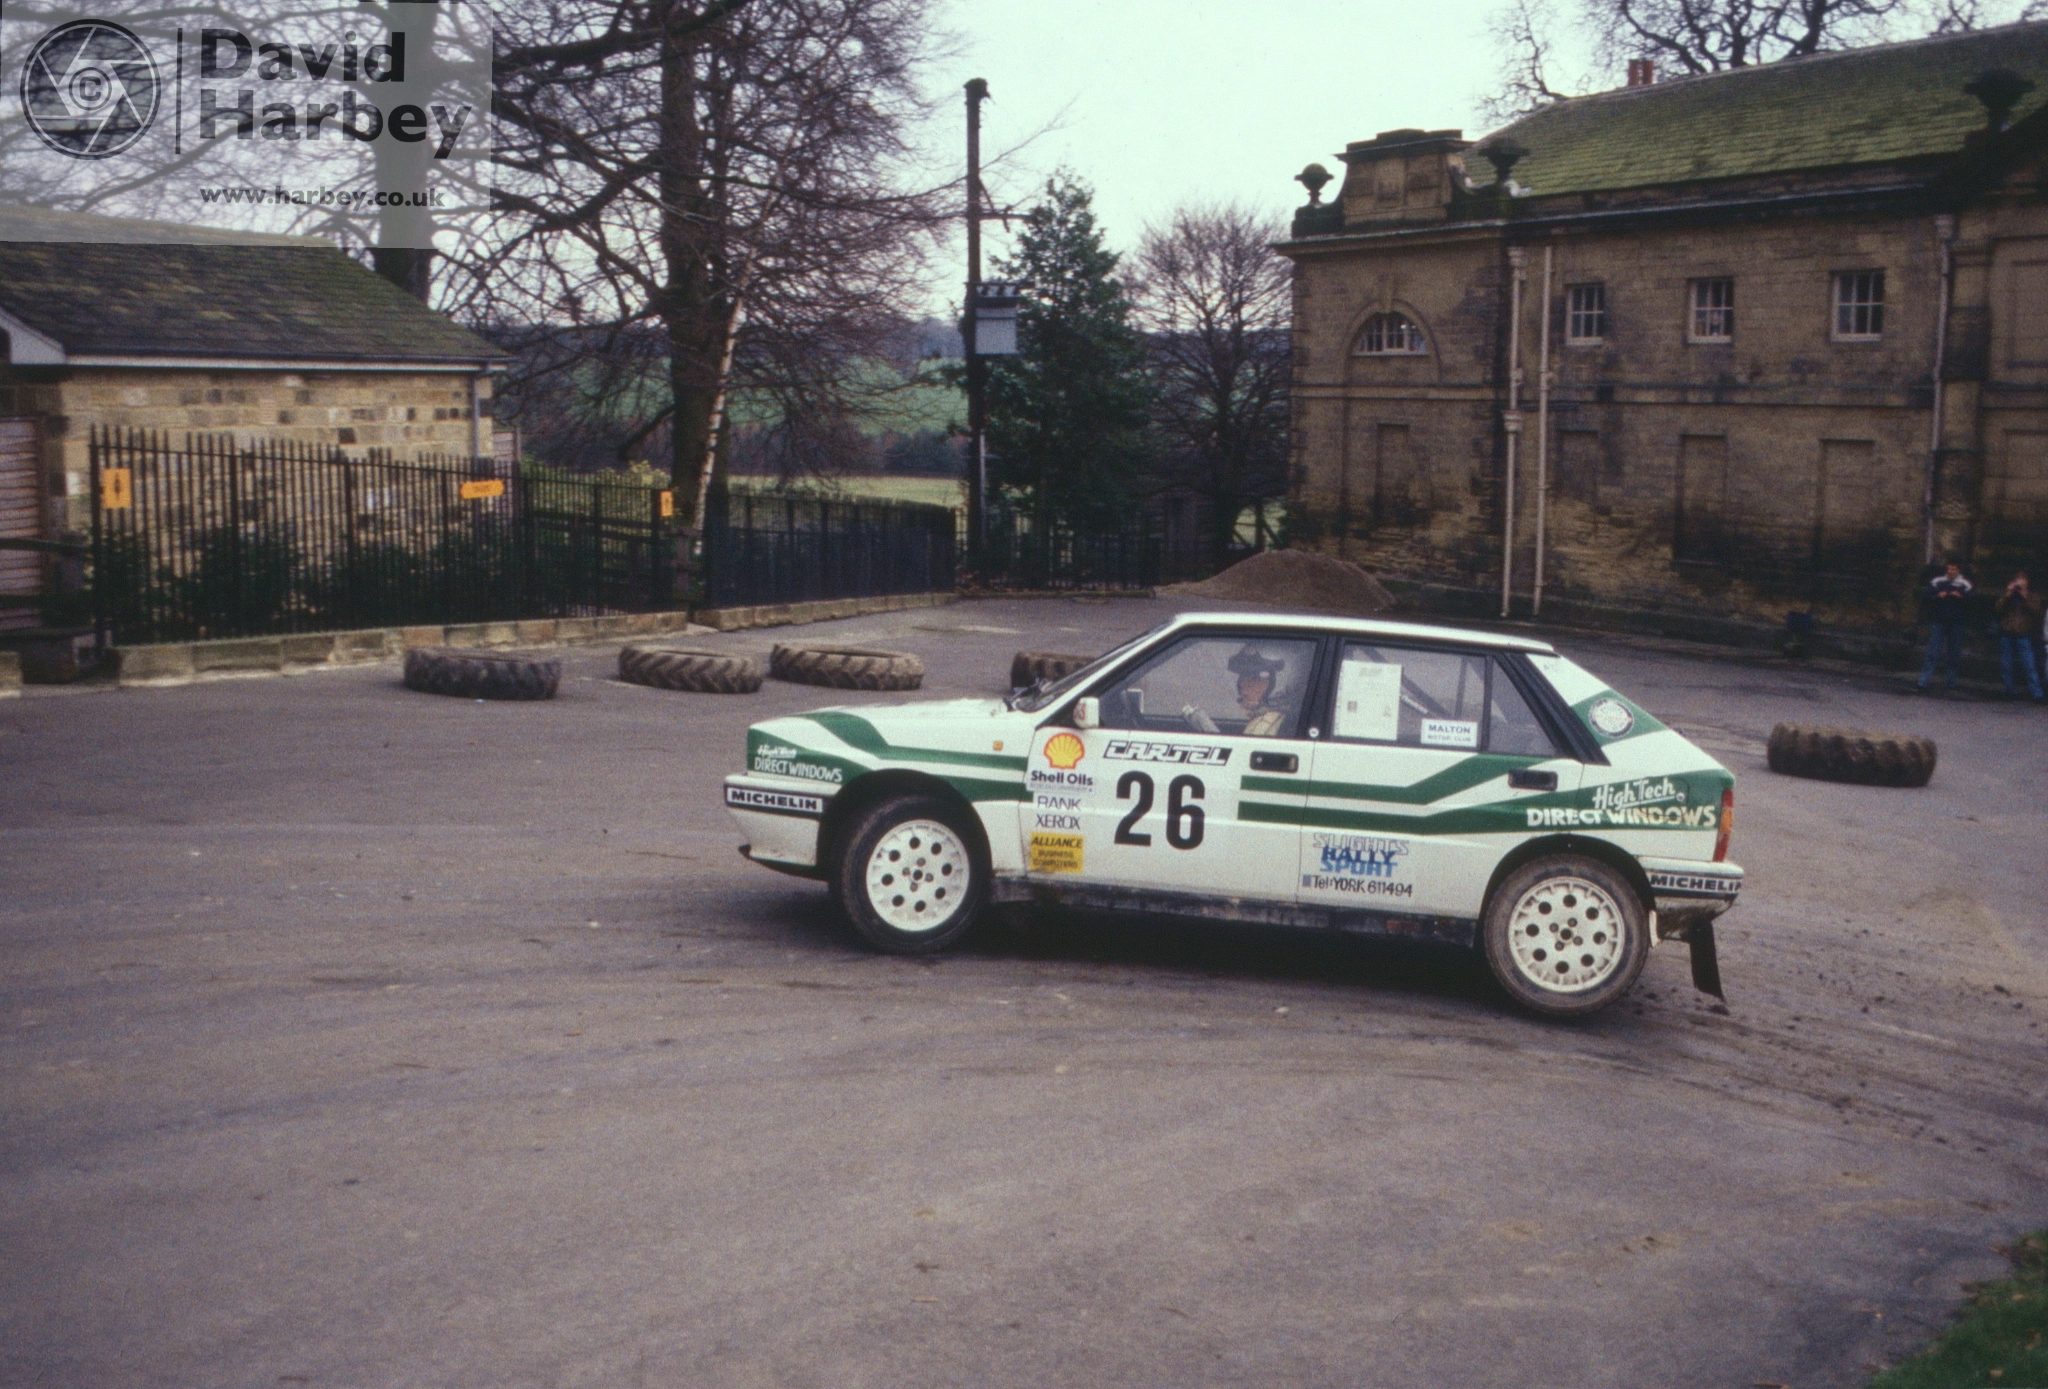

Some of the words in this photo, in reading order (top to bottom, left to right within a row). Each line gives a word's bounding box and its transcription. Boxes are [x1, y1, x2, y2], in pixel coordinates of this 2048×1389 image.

[1428, 724, 1471, 734] MALTON
[1103, 739, 1233, 766] CARTEL
[754, 756, 788, 775] DIRECT
[788, 761, 843, 783] WINDOWS
[1031, 770, 1065, 783] Shell
[1067, 773, 1093, 786] Oils
[731, 789, 818, 810] MICHELIN
[1037, 795, 1081, 811] RANK
[1592, 783, 1635, 812] High
[1634, 777, 1676, 802] Tech
[1114, 770, 1206, 851] 26
[1527, 807, 1603, 827] DIRECT
[1604, 804, 1717, 828] WINDOWS
[1035, 813, 1081, 830] XEROX
[1031, 836, 1082, 848] ALLIANCE
[1313, 832, 1410, 856] SLIGHTS
[1367, 881, 1413, 898] 611494
